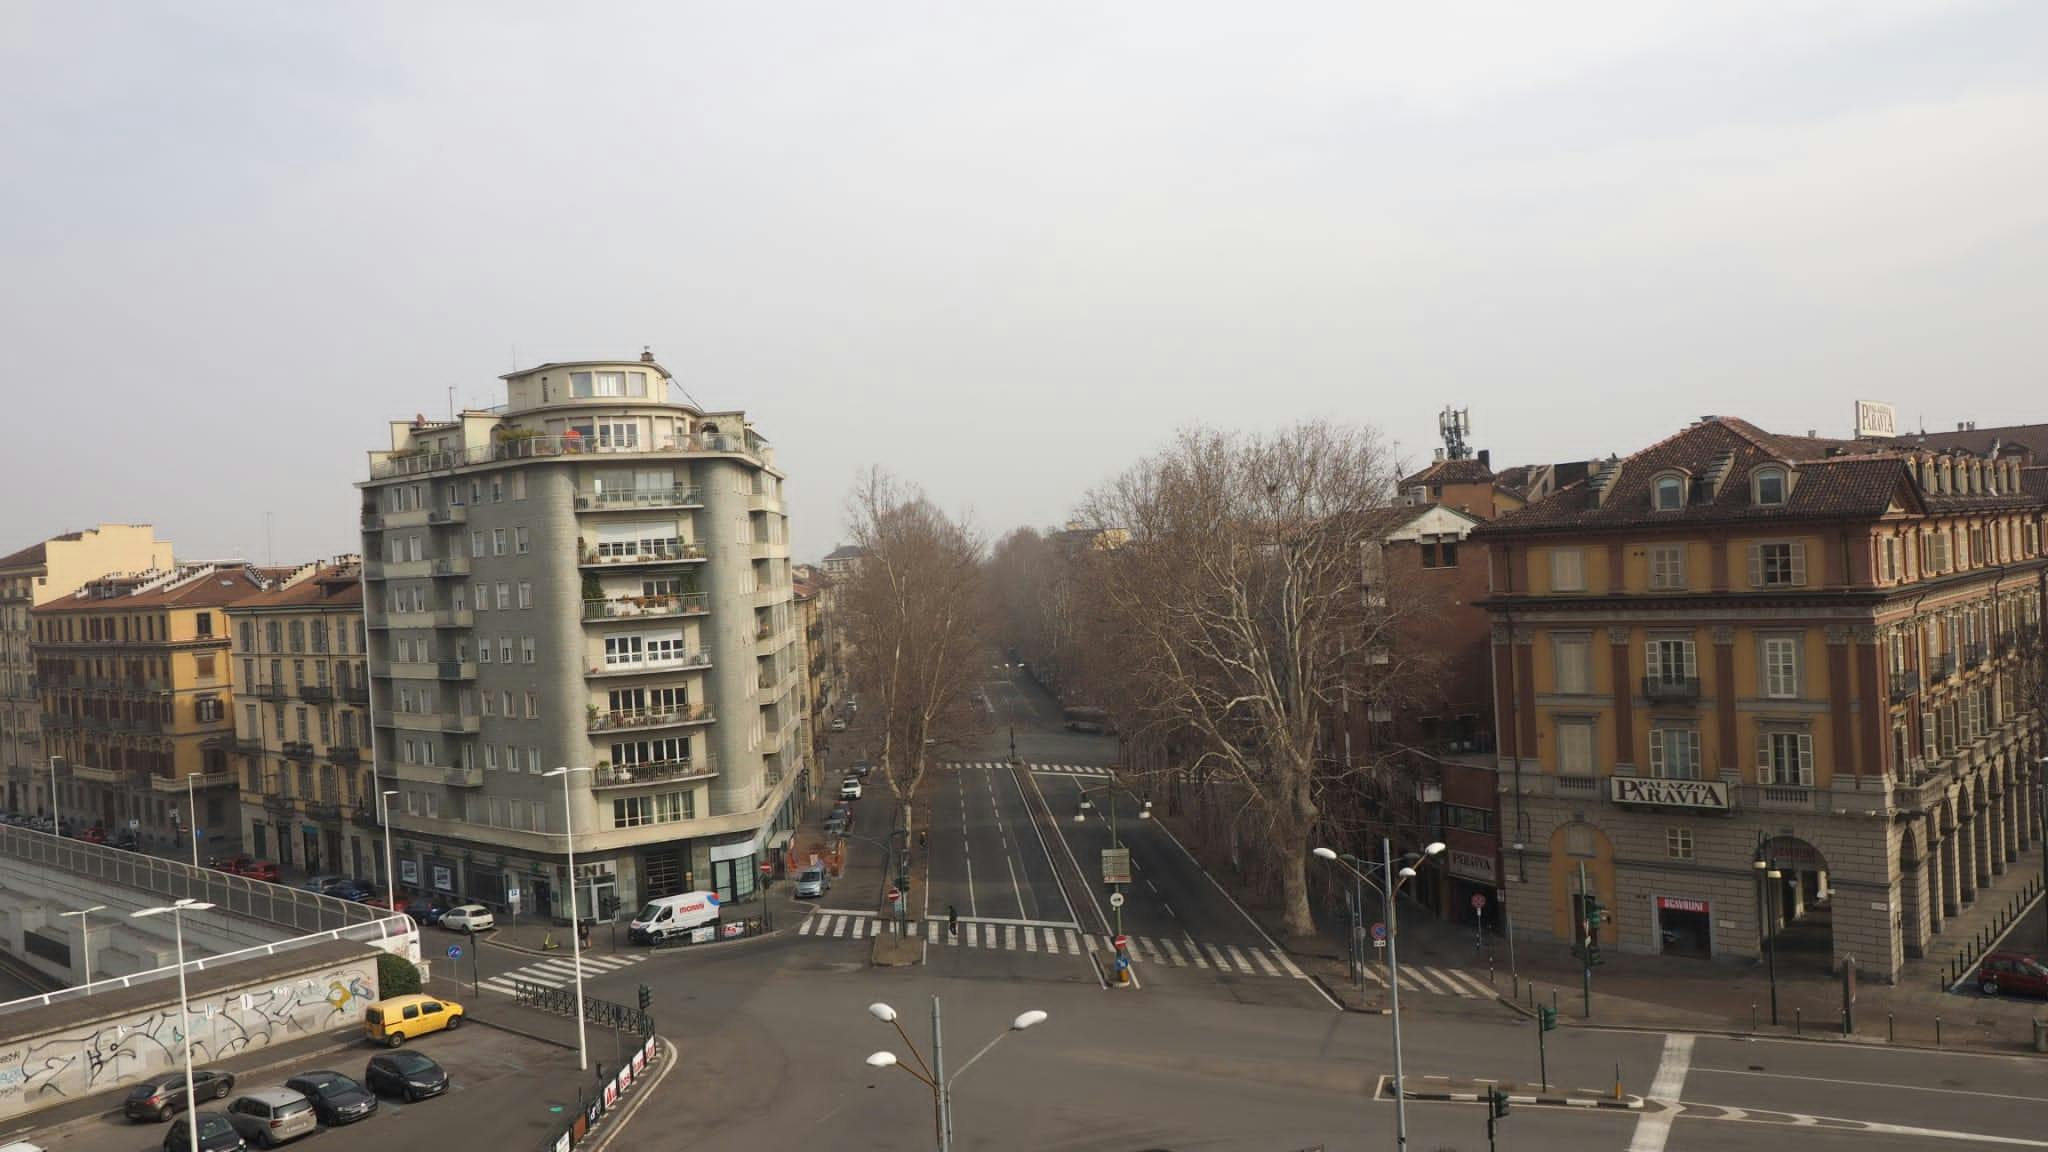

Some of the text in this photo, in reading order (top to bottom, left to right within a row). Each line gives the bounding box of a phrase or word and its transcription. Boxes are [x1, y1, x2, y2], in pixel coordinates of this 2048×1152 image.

[1862, 404, 1895, 433] PARAVIA
[1616, 779, 1723, 806] PARAVIA
[1638, 780, 1707, 792] PALAZZO
